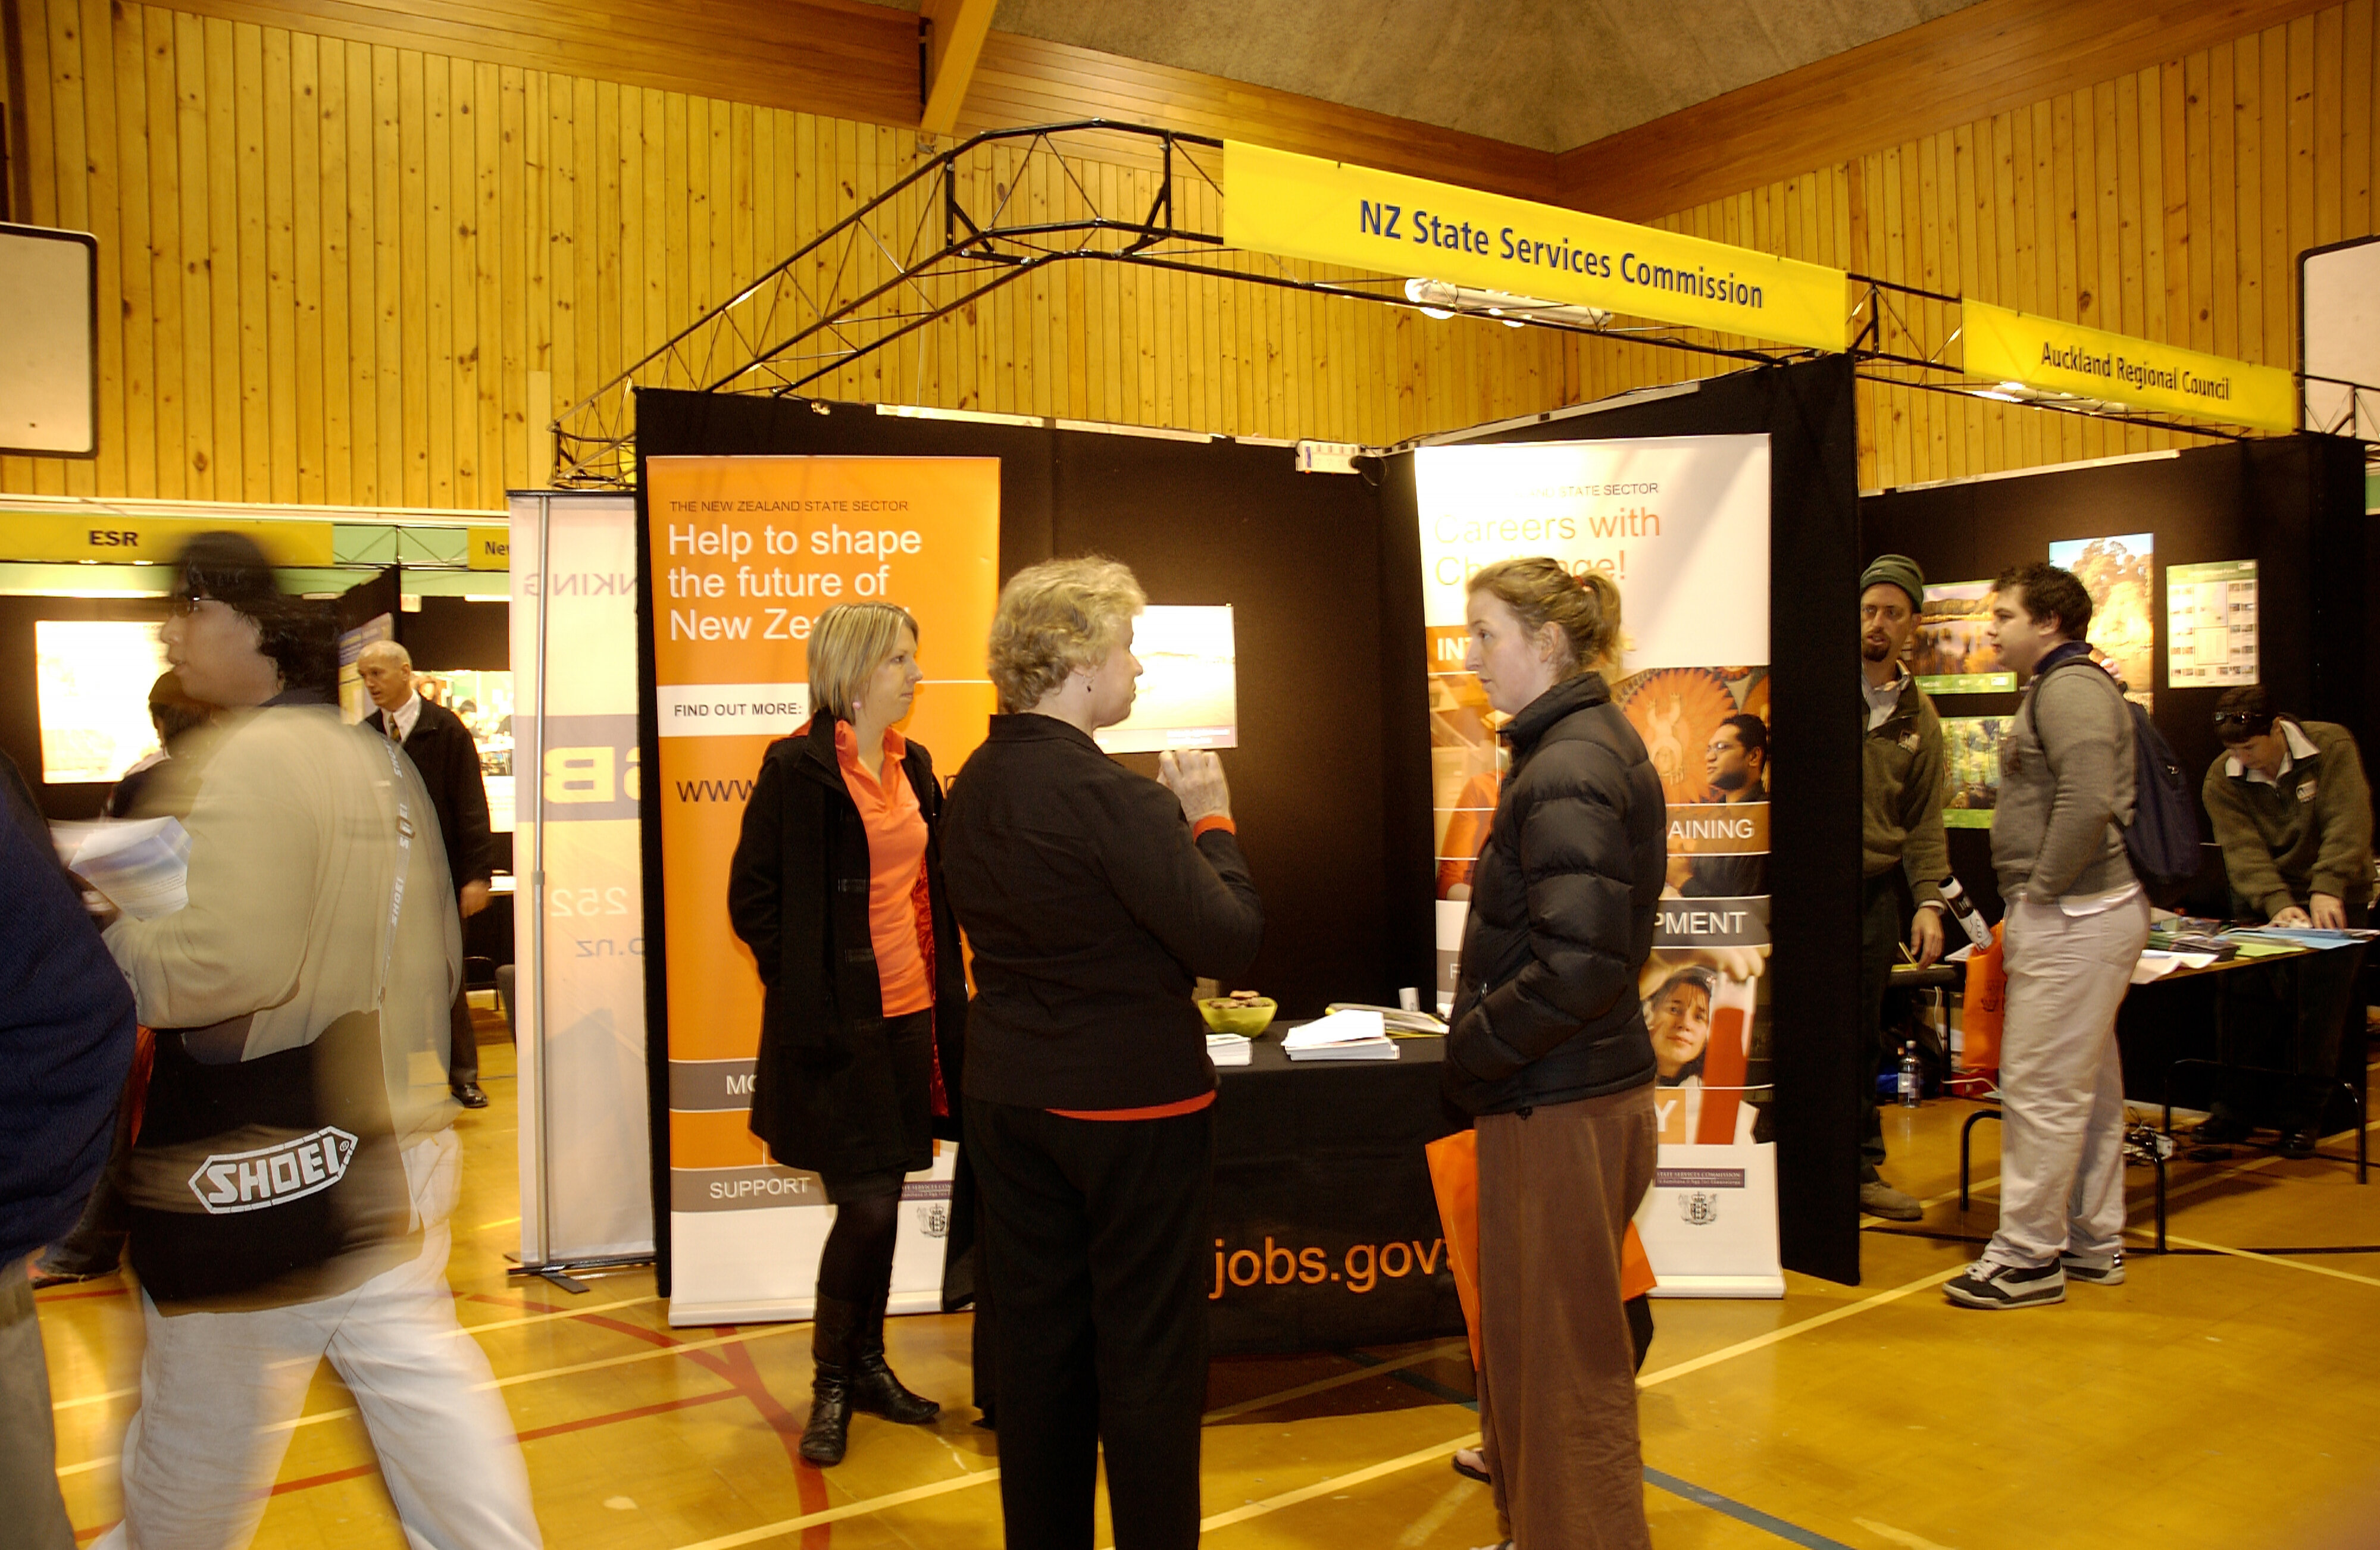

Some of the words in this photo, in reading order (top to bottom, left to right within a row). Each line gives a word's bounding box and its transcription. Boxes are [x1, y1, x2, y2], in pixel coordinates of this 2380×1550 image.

[1359, 199, 1402, 240] NZ
[1413, 211, 1490, 256] State
[1500, 227, 1611, 279] Services
[1620, 253, 1764, 310] Commission
[2041, 342, 2111, 378] Auckland
[2117, 358, 2178, 390] Regional
[2182, 371, 2231, 400] Council
[670, 501, 697, 512] THE
[701, 500, 733, 511] NEW
[737, 500, 800, 512] ZEALAND
[805, 500, 848, 511] STATE
[852, 500, 909, 511] SECTOR
[1559, 486, 1600, 497] STATE
[1603, 483, 1659, 496] SECTOR
[89, 530, 139, 546] ESR
[1435, 514, 1577, 544] Careers
[1588, 507, 1660, 538] with
[668, 524, 752, 562] Help
[764, 525, 798, 555] to
[811, 524, 922, 560] shape
[668, 567, 724, 598] the
[737, 566, 843, 597] future
[854, 565, 890, 596] of
[670, 609, 751, 641] New
[674, 704, 709, 717] FIND
[714, 704, 746, 716] OUT
[752, 703, 802, 716] MORE:
[1668, 819, 1755, 840] AINING
[391, 878, 405, 928] SHOEI
[207, 1136, 340, 1203] SHOEI
[709, 1176, 811, 1200] SUPPORT
[1208, 1236, 1453, 1300] jobs.gov
